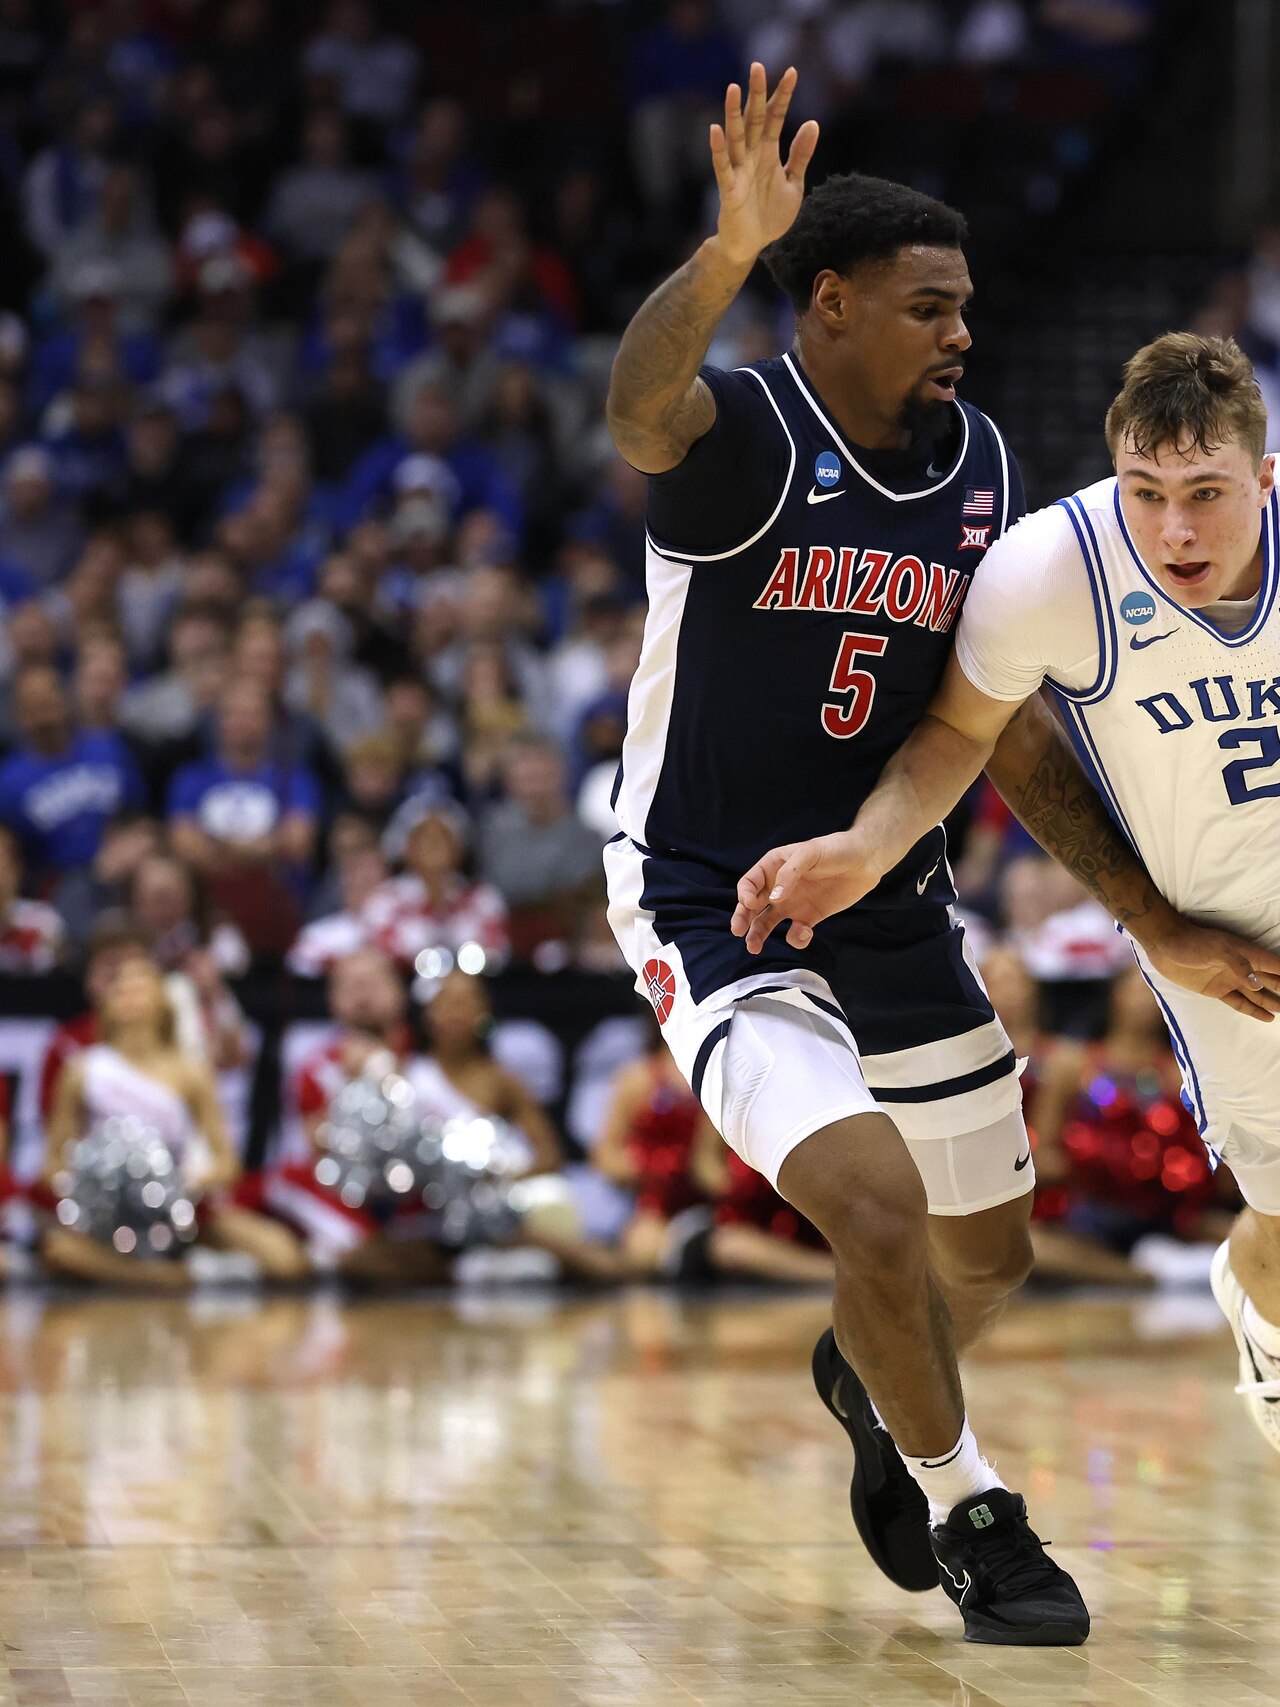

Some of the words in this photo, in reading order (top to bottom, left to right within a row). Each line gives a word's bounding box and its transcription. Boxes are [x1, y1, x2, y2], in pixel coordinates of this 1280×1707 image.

[817, 467, 840, 479] NCAA
[960, 526, 990, 548] XII
[752, 546, 970, 633] ARIZONA
[1125, 606, 1154, 618] NCAA
[821, 632, 889, 739] 5
